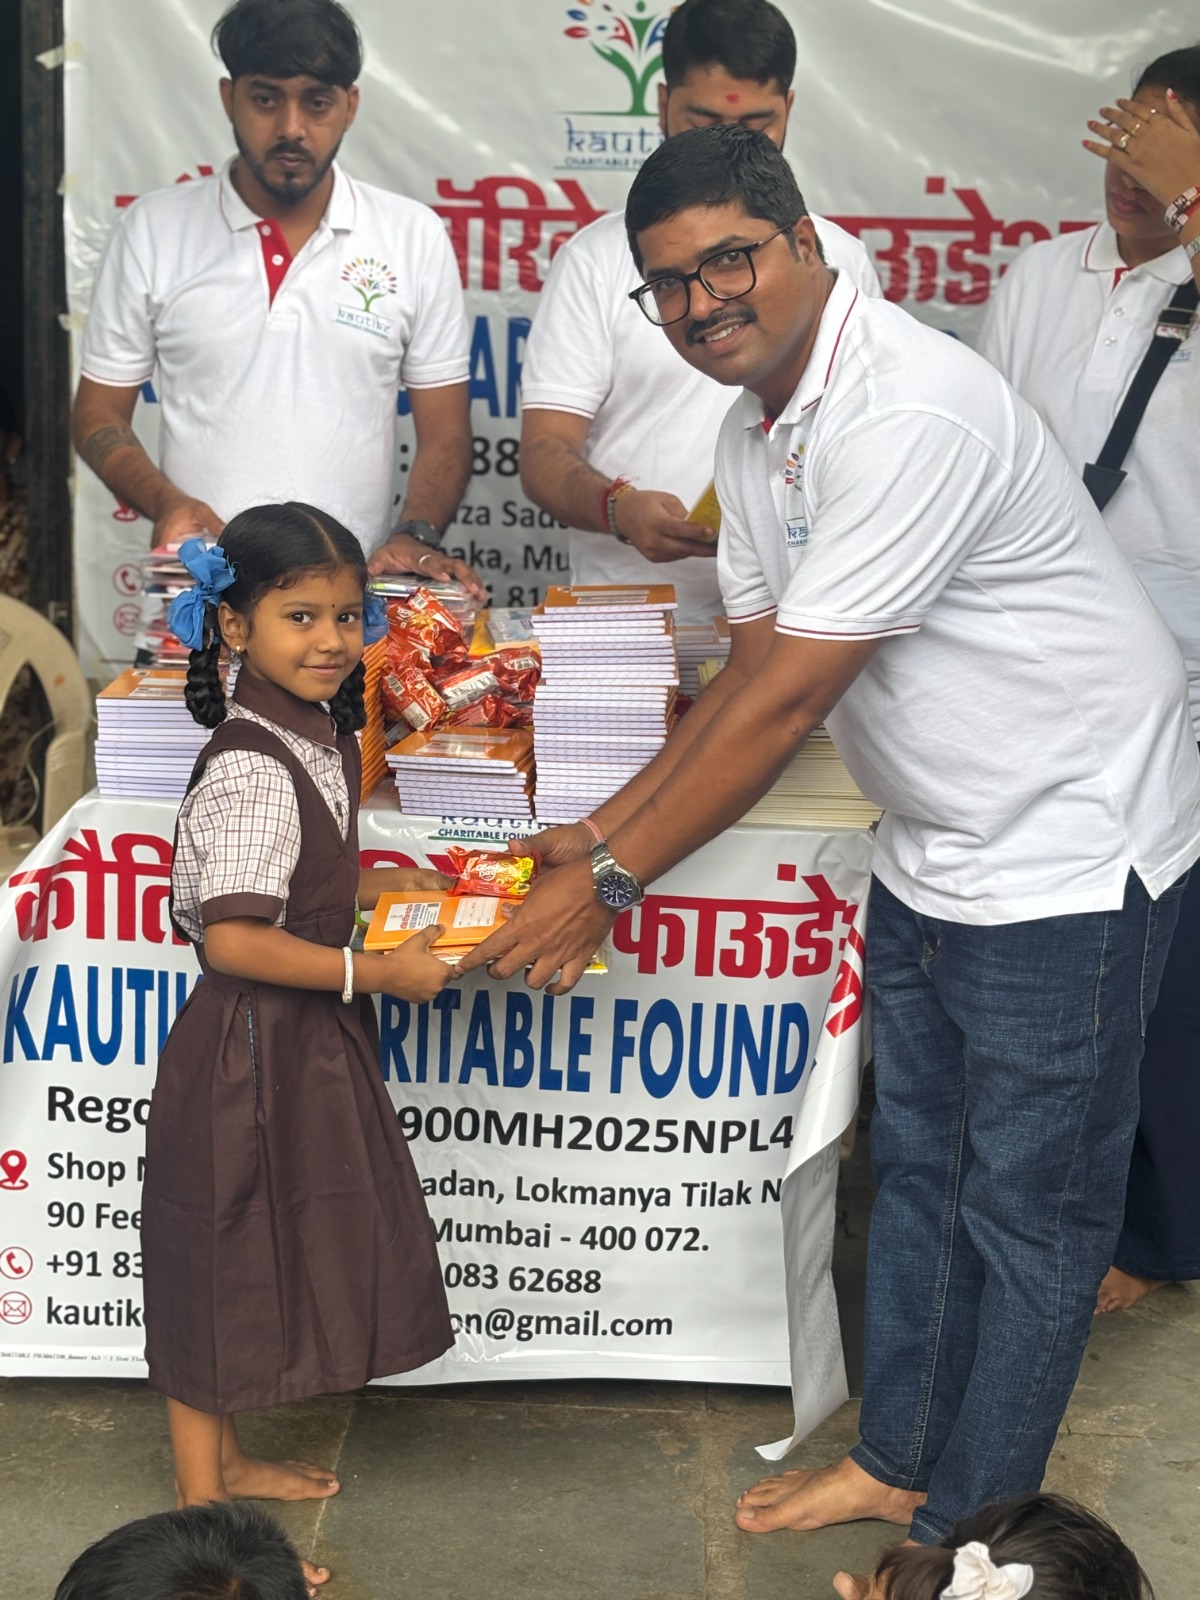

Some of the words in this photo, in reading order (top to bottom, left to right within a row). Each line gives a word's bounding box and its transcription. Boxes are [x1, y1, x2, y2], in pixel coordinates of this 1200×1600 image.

[565, 117, 664, 152] kaut
[438, 828, 501, 840] CHARITABLE
[3, 964, 203, 1066] KAUTI
[380, 987, 595, 1093] RITABLE
[609, 998, 812, 1099] FOUND
[397, 1105, 794, 1154] 900MH2025NPL4
[47, 1151, 126, 1188] Shop
[421, 1169, 504, 1205] adan,
[516, 1176, 671, 1213] Lokmanya
[681, 1180, 753, 1207] Tilak
[47, 1201, 85, 1228] 90
[96, 1202, 142, 1230] Fee
[430, 1217, 551, 1248] Mumbai
[579, 1225, 637, 1251] 400
[645, 1226, 709, 1252] 072.
[46, 1250, 102, 1277] +91
[112, 1251, 143, 1278] 83
[444, 1262, 499, 1289] 083
[508, 1266, 602, 1293] 62688
[47, 1296, 143, 1327] kautik
[449, 1308, 673, 1342] on@gmail.com
